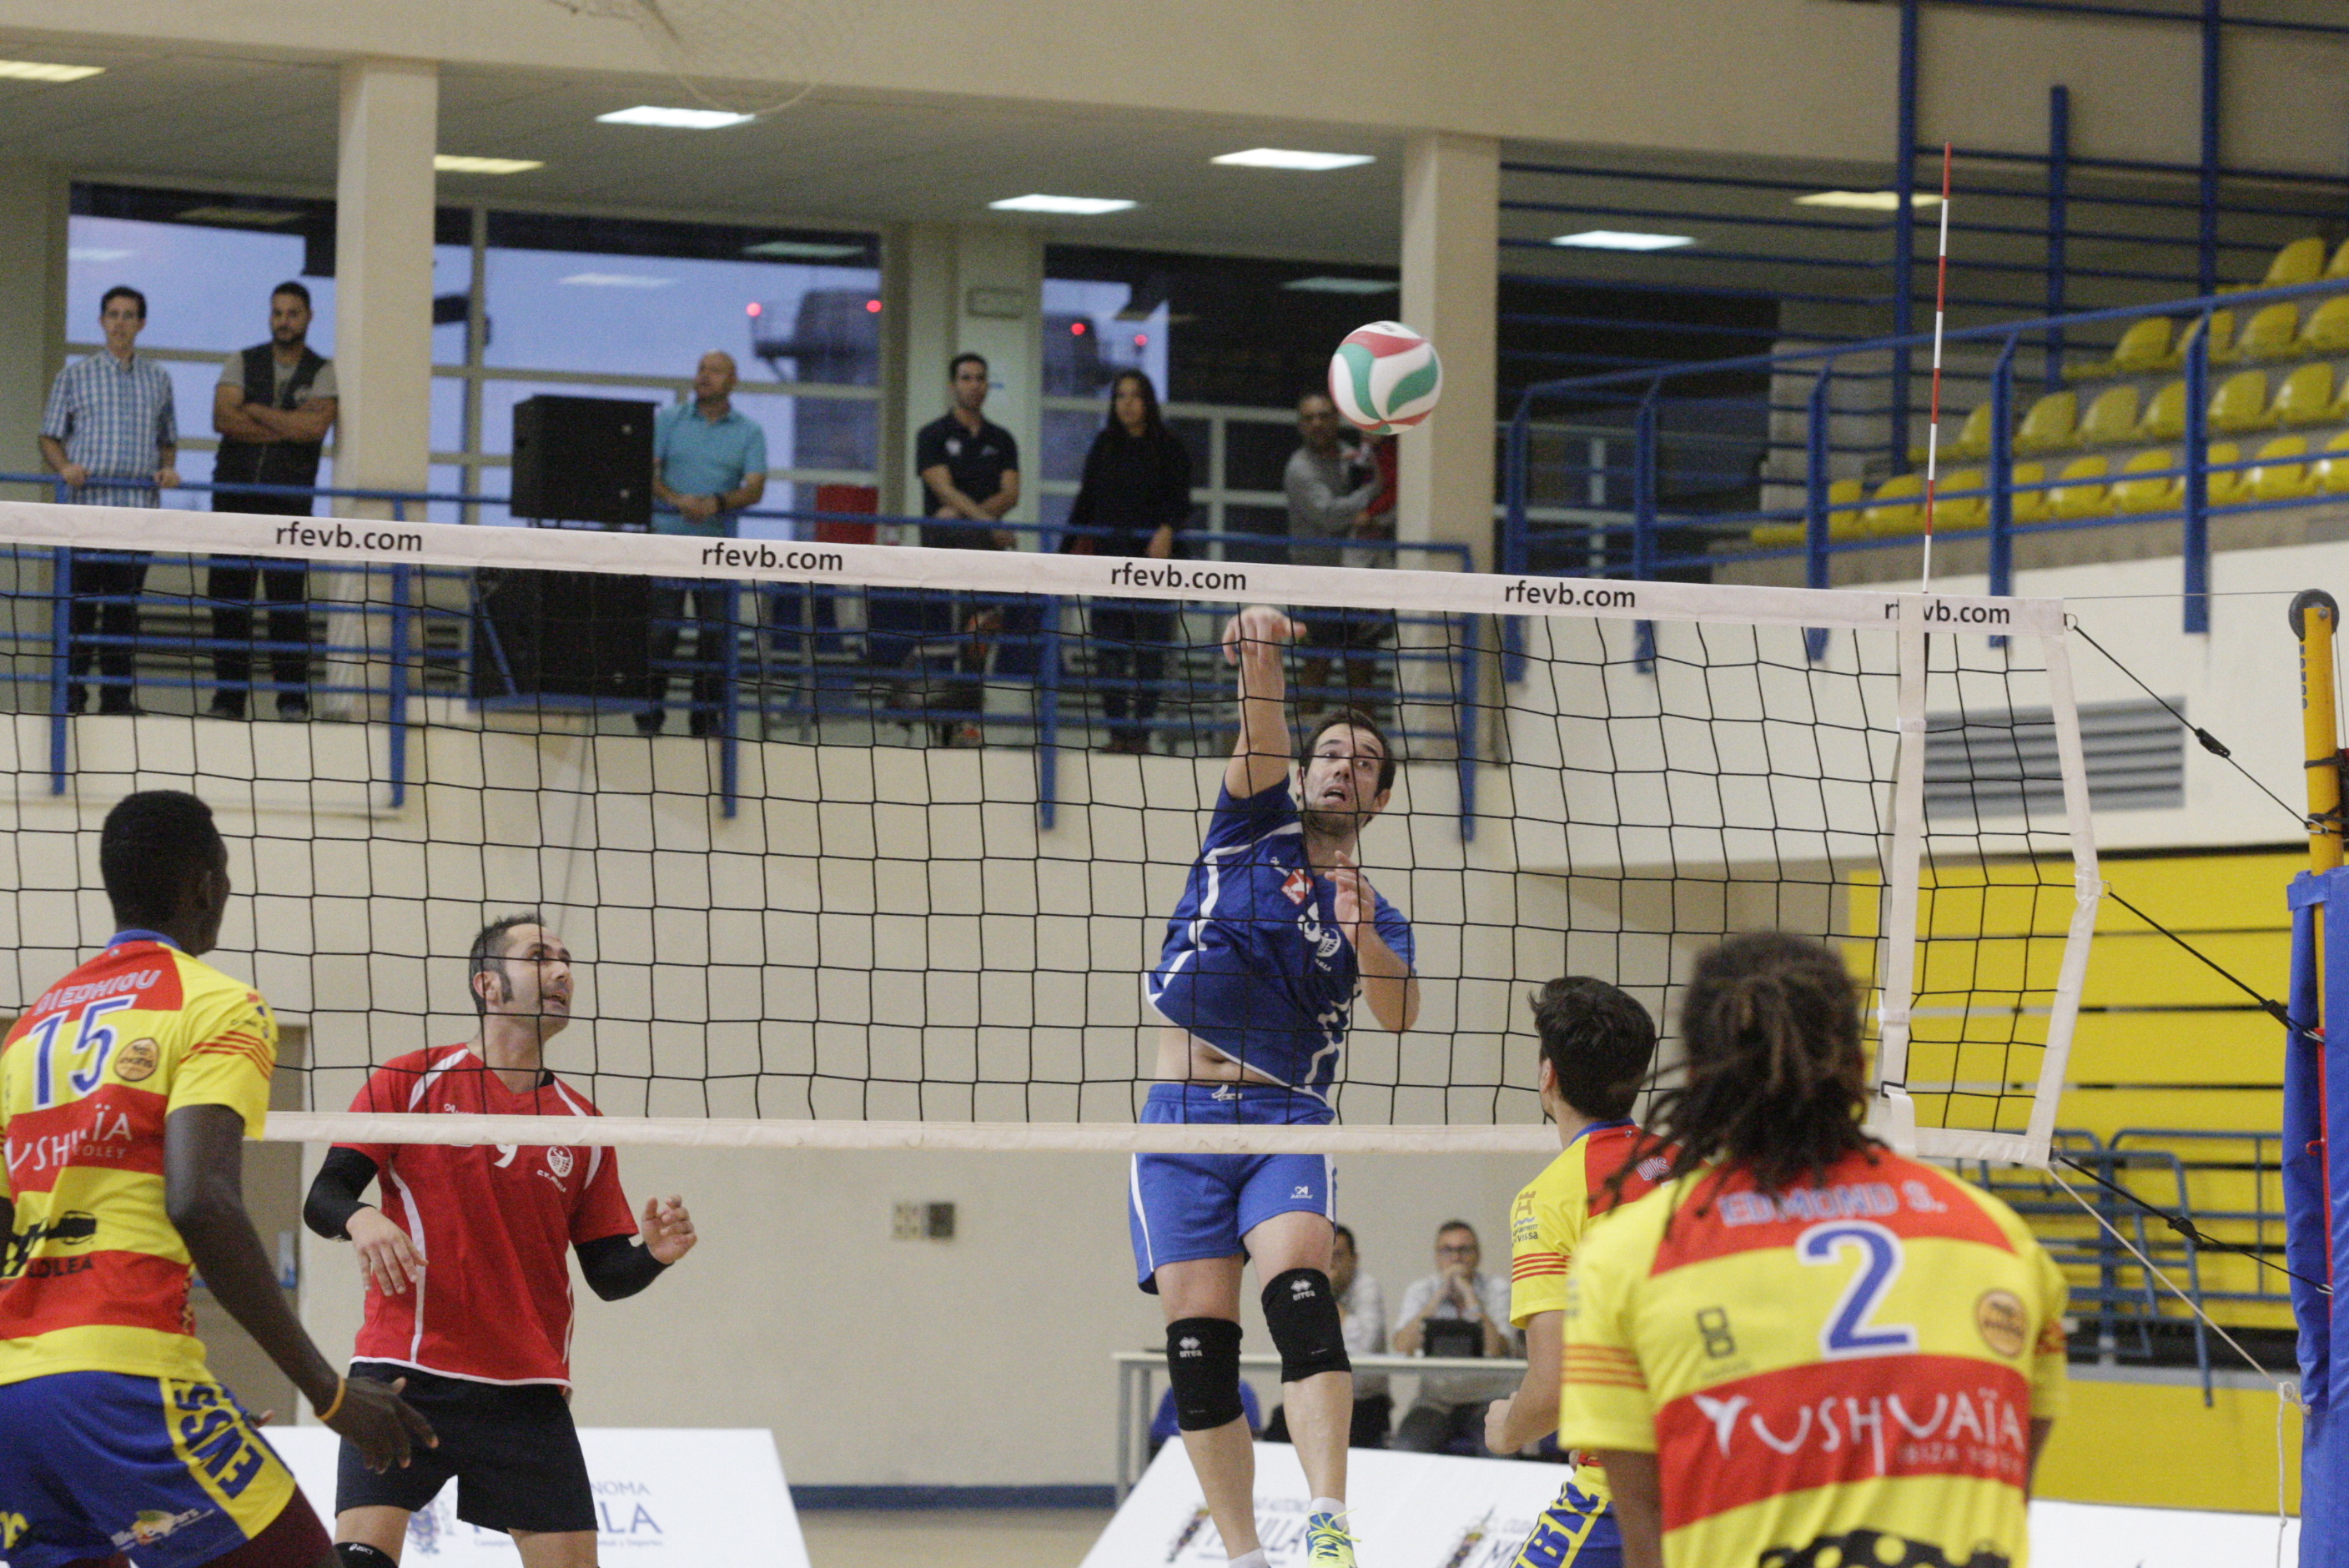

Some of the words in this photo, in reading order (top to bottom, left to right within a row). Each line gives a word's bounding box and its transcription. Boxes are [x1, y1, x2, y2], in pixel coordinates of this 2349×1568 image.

[276, 522, 423, 553] rfevb.com
[702, 541, 844, 571] rfevb.com
[1111, 562, 1247, 592] rfevb.com
[1505, 580, 1637, 610] rfevb.com
[1885, 599, 2010, 625] rfvb.com
[27, 994, 138, 1112] 15
[1718, 1185, 1899, 1228] EDMOND
[1902, 1180, 1948, 1214] S.
[1794, 1219, 1918, 1362] 2
[591, 1480, 651, 1495] NOMA
